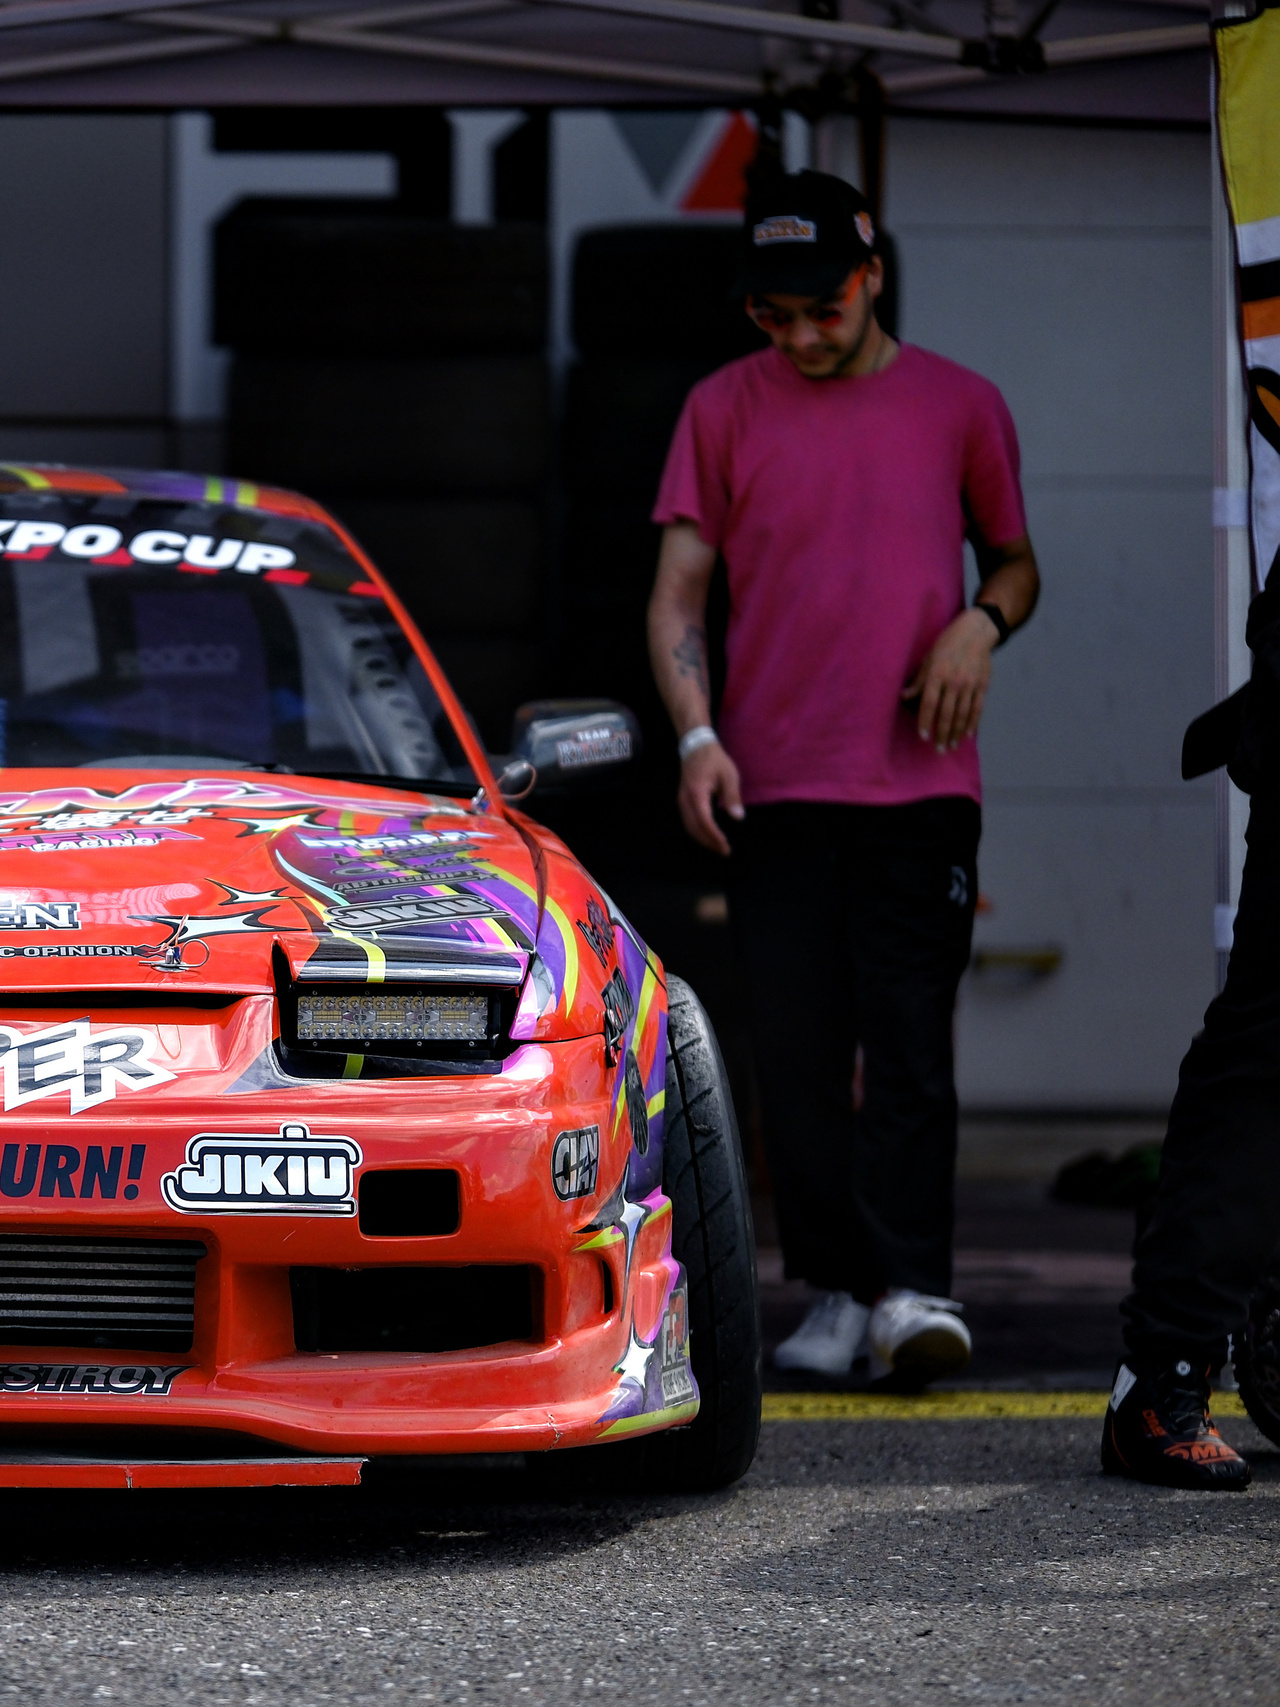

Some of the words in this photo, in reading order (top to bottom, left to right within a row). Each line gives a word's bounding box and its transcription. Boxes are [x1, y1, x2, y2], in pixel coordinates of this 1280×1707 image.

[127, 528, 297, 574] CUP
[30, 836, 159, 852] RACING
[333, 897, 495, 927] JIKIU
[23, 945, 134, 959] OPINION
[180, 1152, 349, 1198] JIKIU
